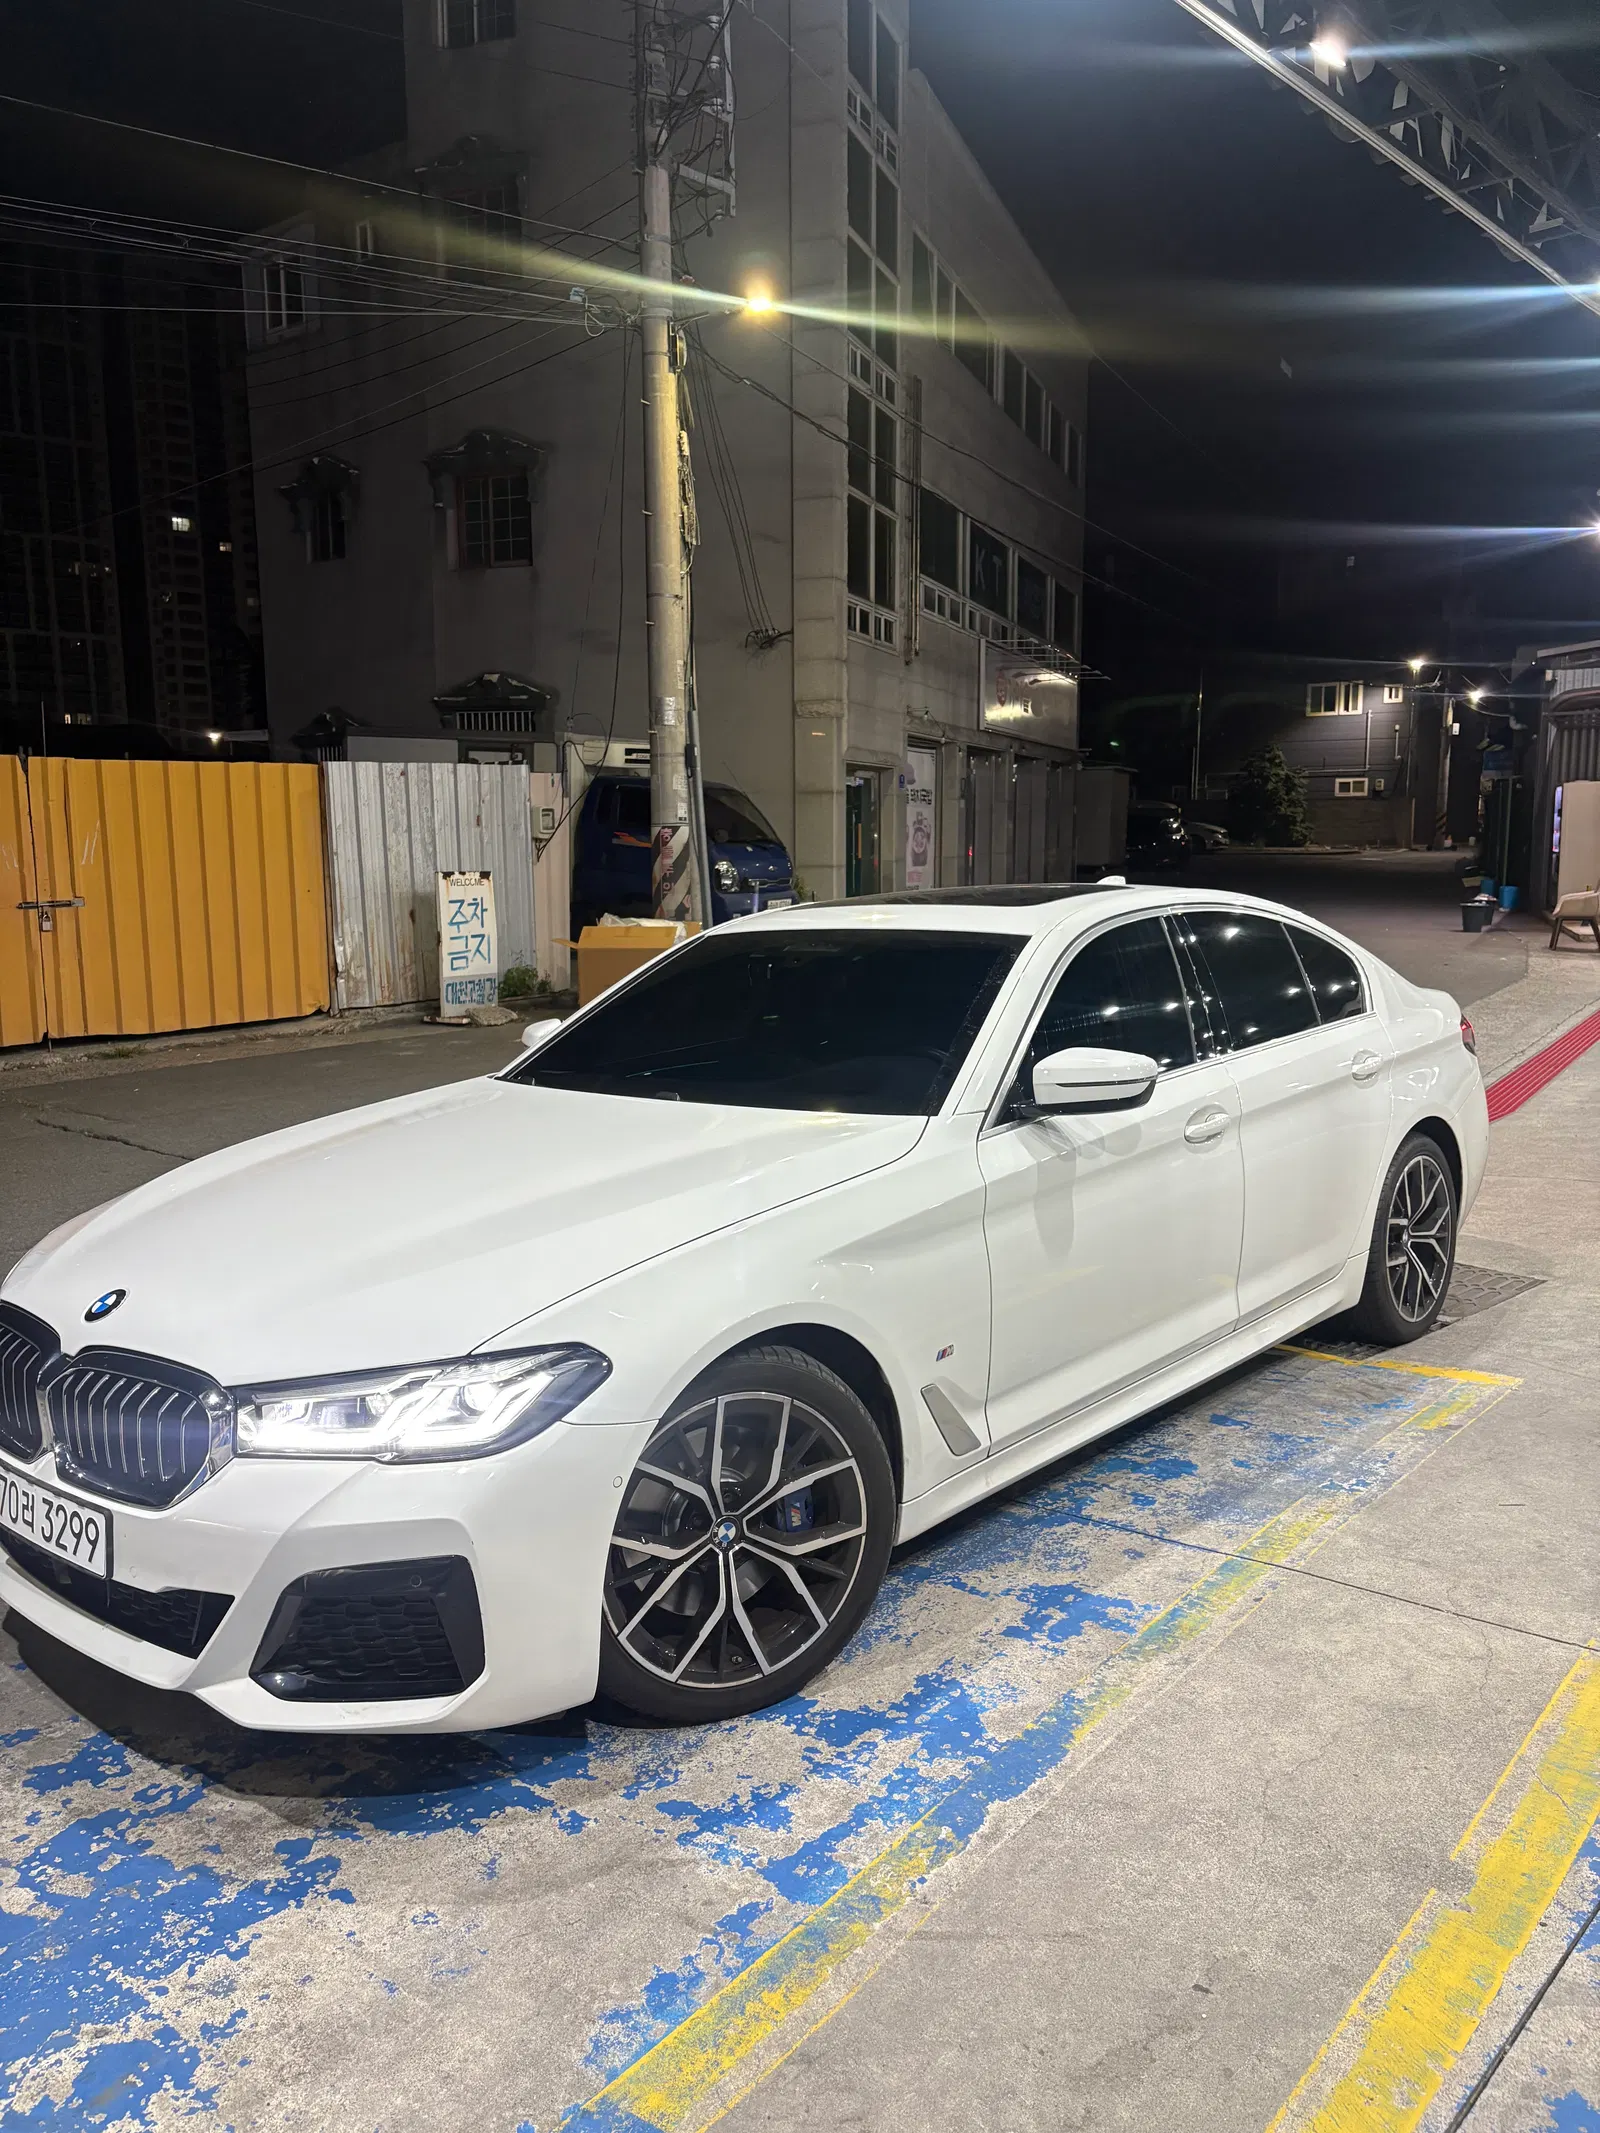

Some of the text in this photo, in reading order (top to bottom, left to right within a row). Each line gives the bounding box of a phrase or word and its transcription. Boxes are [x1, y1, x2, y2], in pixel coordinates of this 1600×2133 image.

[447, 896, 488, 934] 주차
[447, 933, 491, 971] 금지
[41, 1497, 100, 1563] 3299
